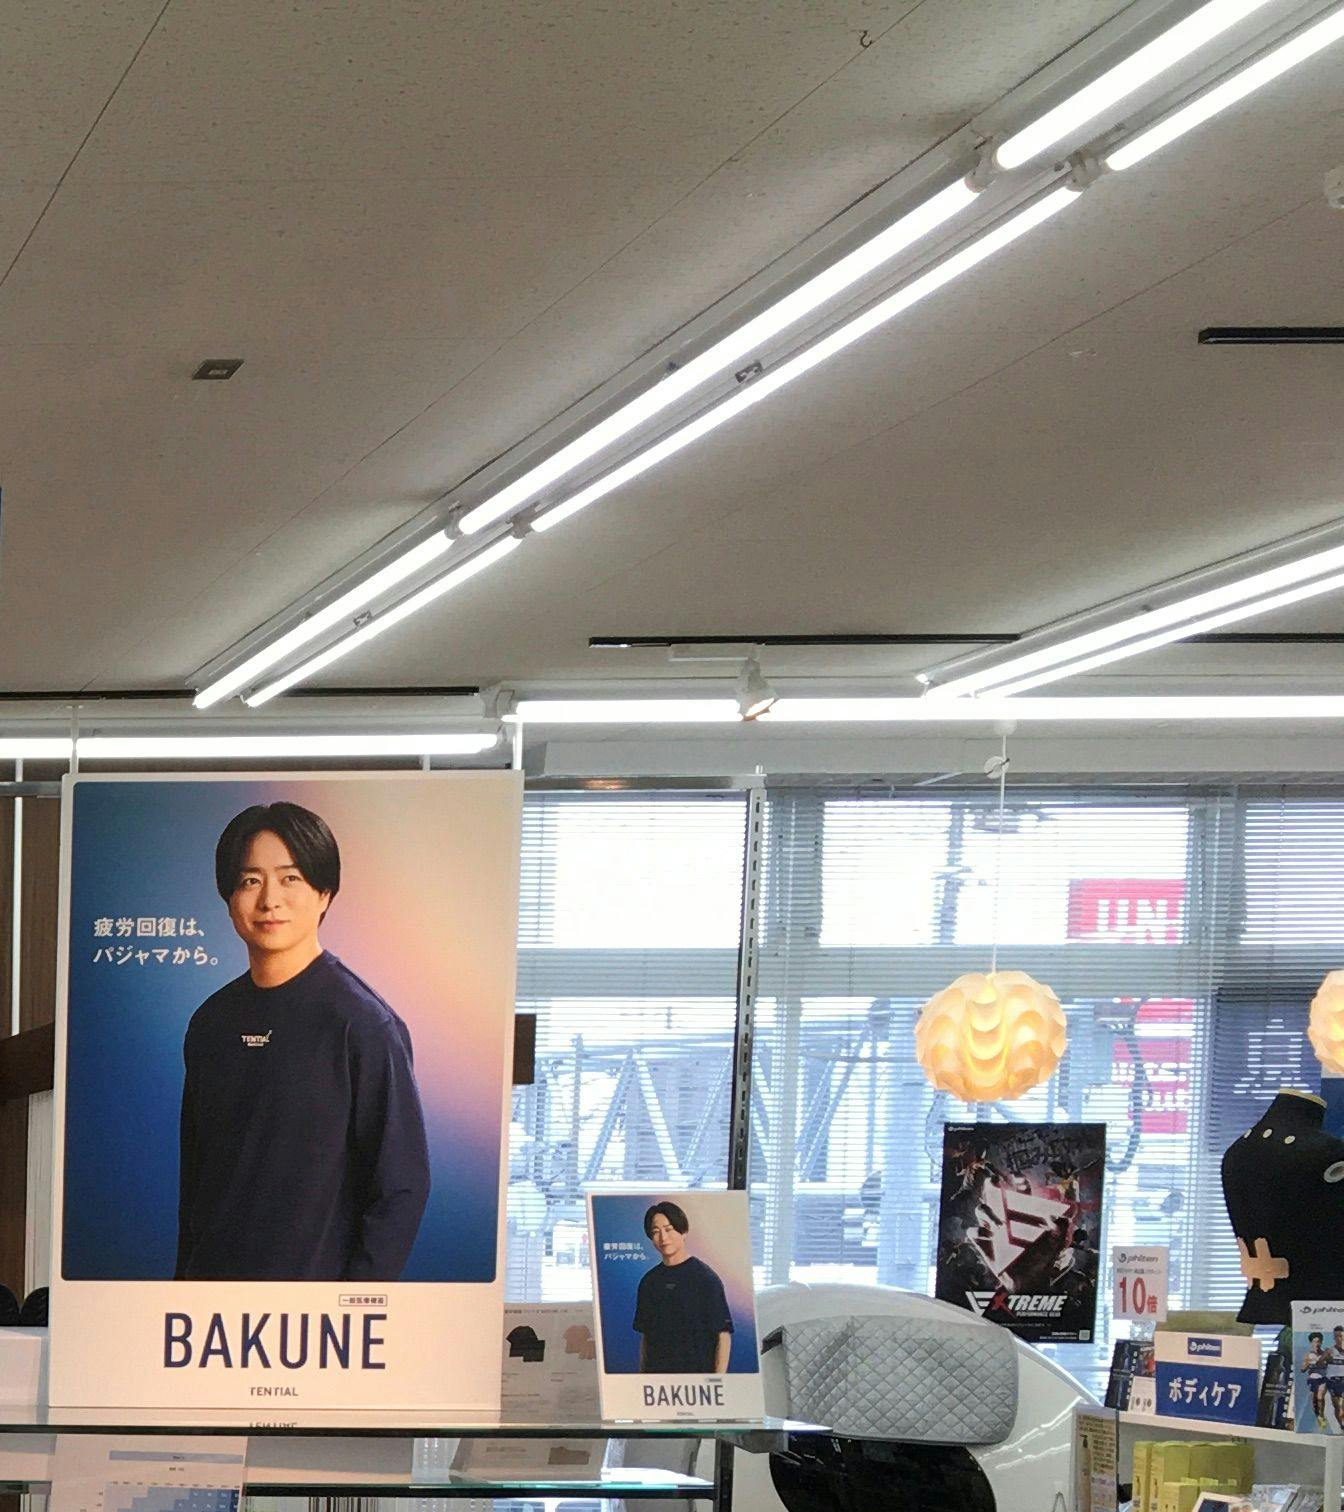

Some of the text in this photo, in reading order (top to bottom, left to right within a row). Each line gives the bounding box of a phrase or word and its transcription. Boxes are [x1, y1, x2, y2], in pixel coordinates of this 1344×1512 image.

[93, 917, 205, 937] 疲労回復は、
[93, 945, 218, 966] パジャマから。
[1119, 1276, 1158, 1314] 10倍
[163, 1312, 388, 1369] BAKUNE
[249, 1386, 298, 1397] TENTIAL
[643, 1385, 725, 1406] BAKUNE
[1168, 1377, 1242, 1408] ボディケア
